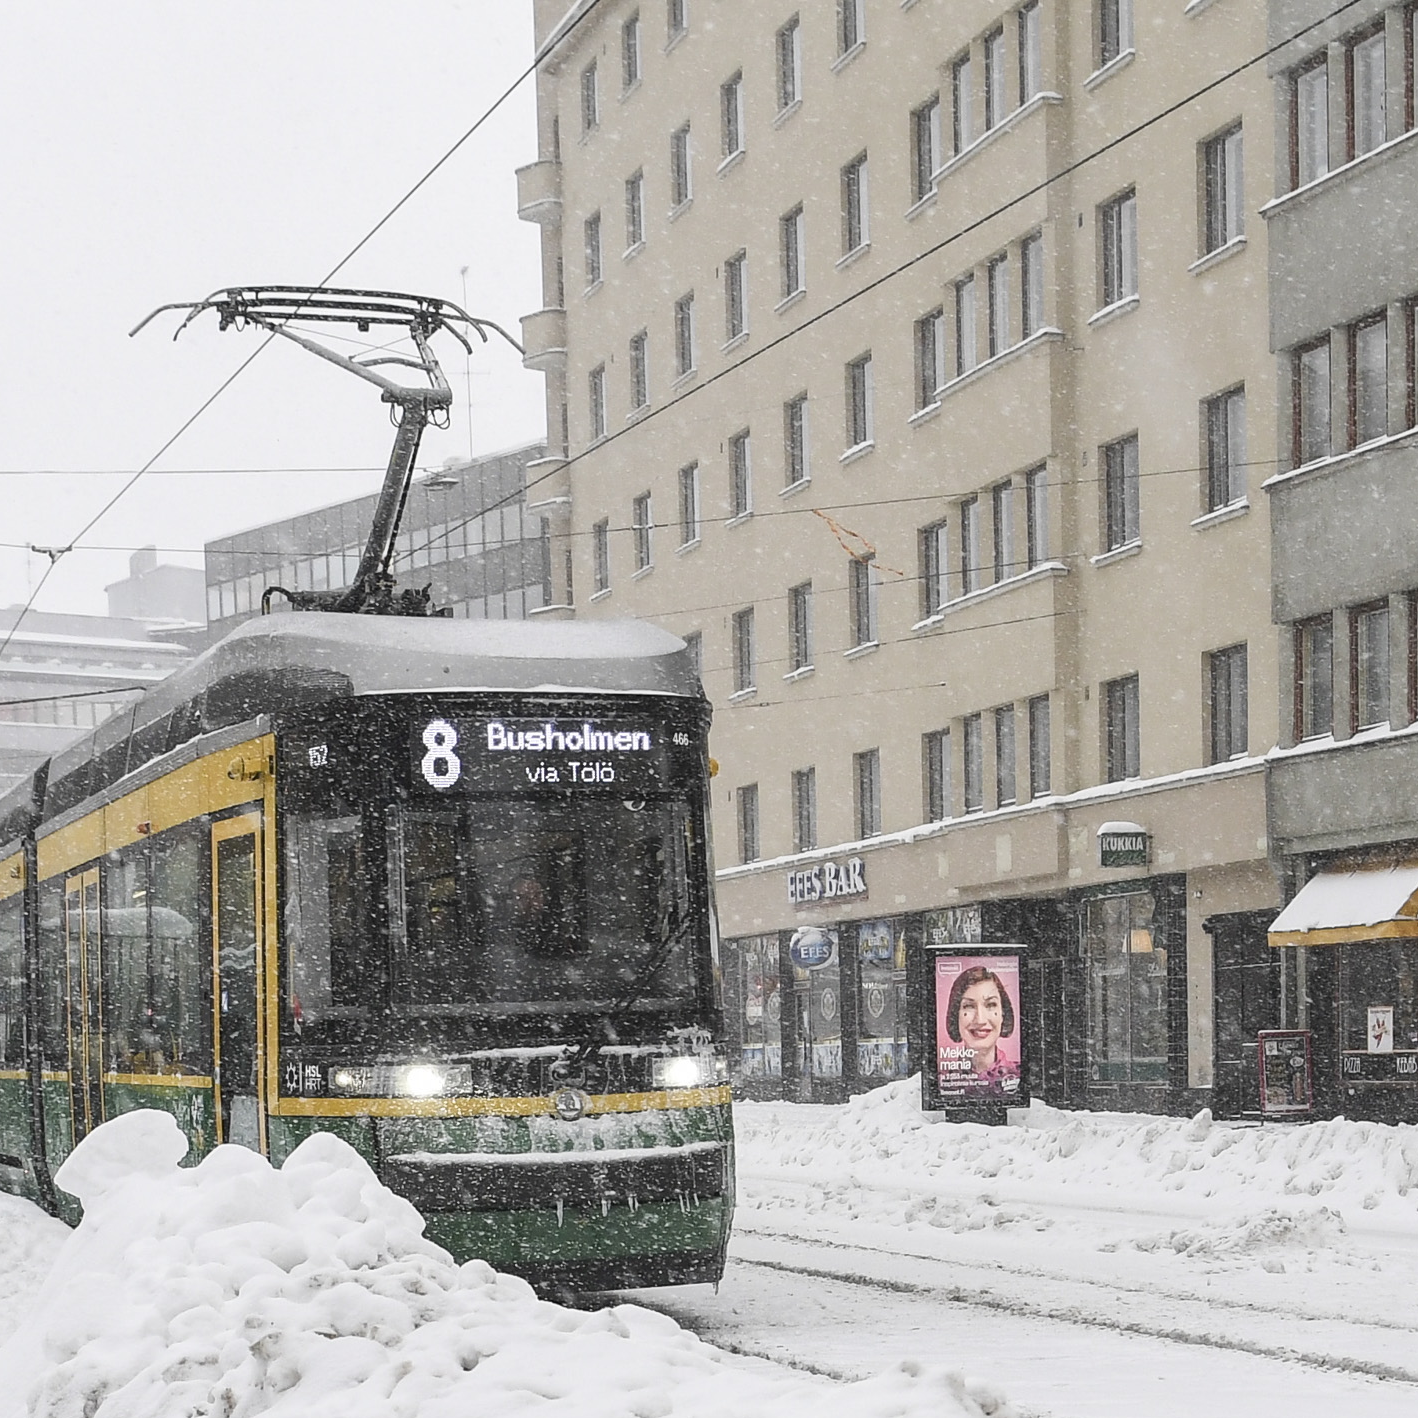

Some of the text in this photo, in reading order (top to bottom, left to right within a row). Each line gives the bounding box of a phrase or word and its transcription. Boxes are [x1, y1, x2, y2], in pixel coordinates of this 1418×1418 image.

[487, 723, 650, 751] Busholmen
[672, 731, 689, 746] 466
[421, 718, 462, 789] 8
[526, 761, 616, 783] via Tölö
[1102, 836, 1144, 851] KUKKIA
[787, 857, 866, 903] EFES BAR
[800, 945, 830, 959] EFES
[939, 1045, 979, 1059] Mekko-
[305, 1064, 322, 1078] HSL
[939, 1058, 972, 1070] mania
[305, 1078, 322, 1091] HRT
